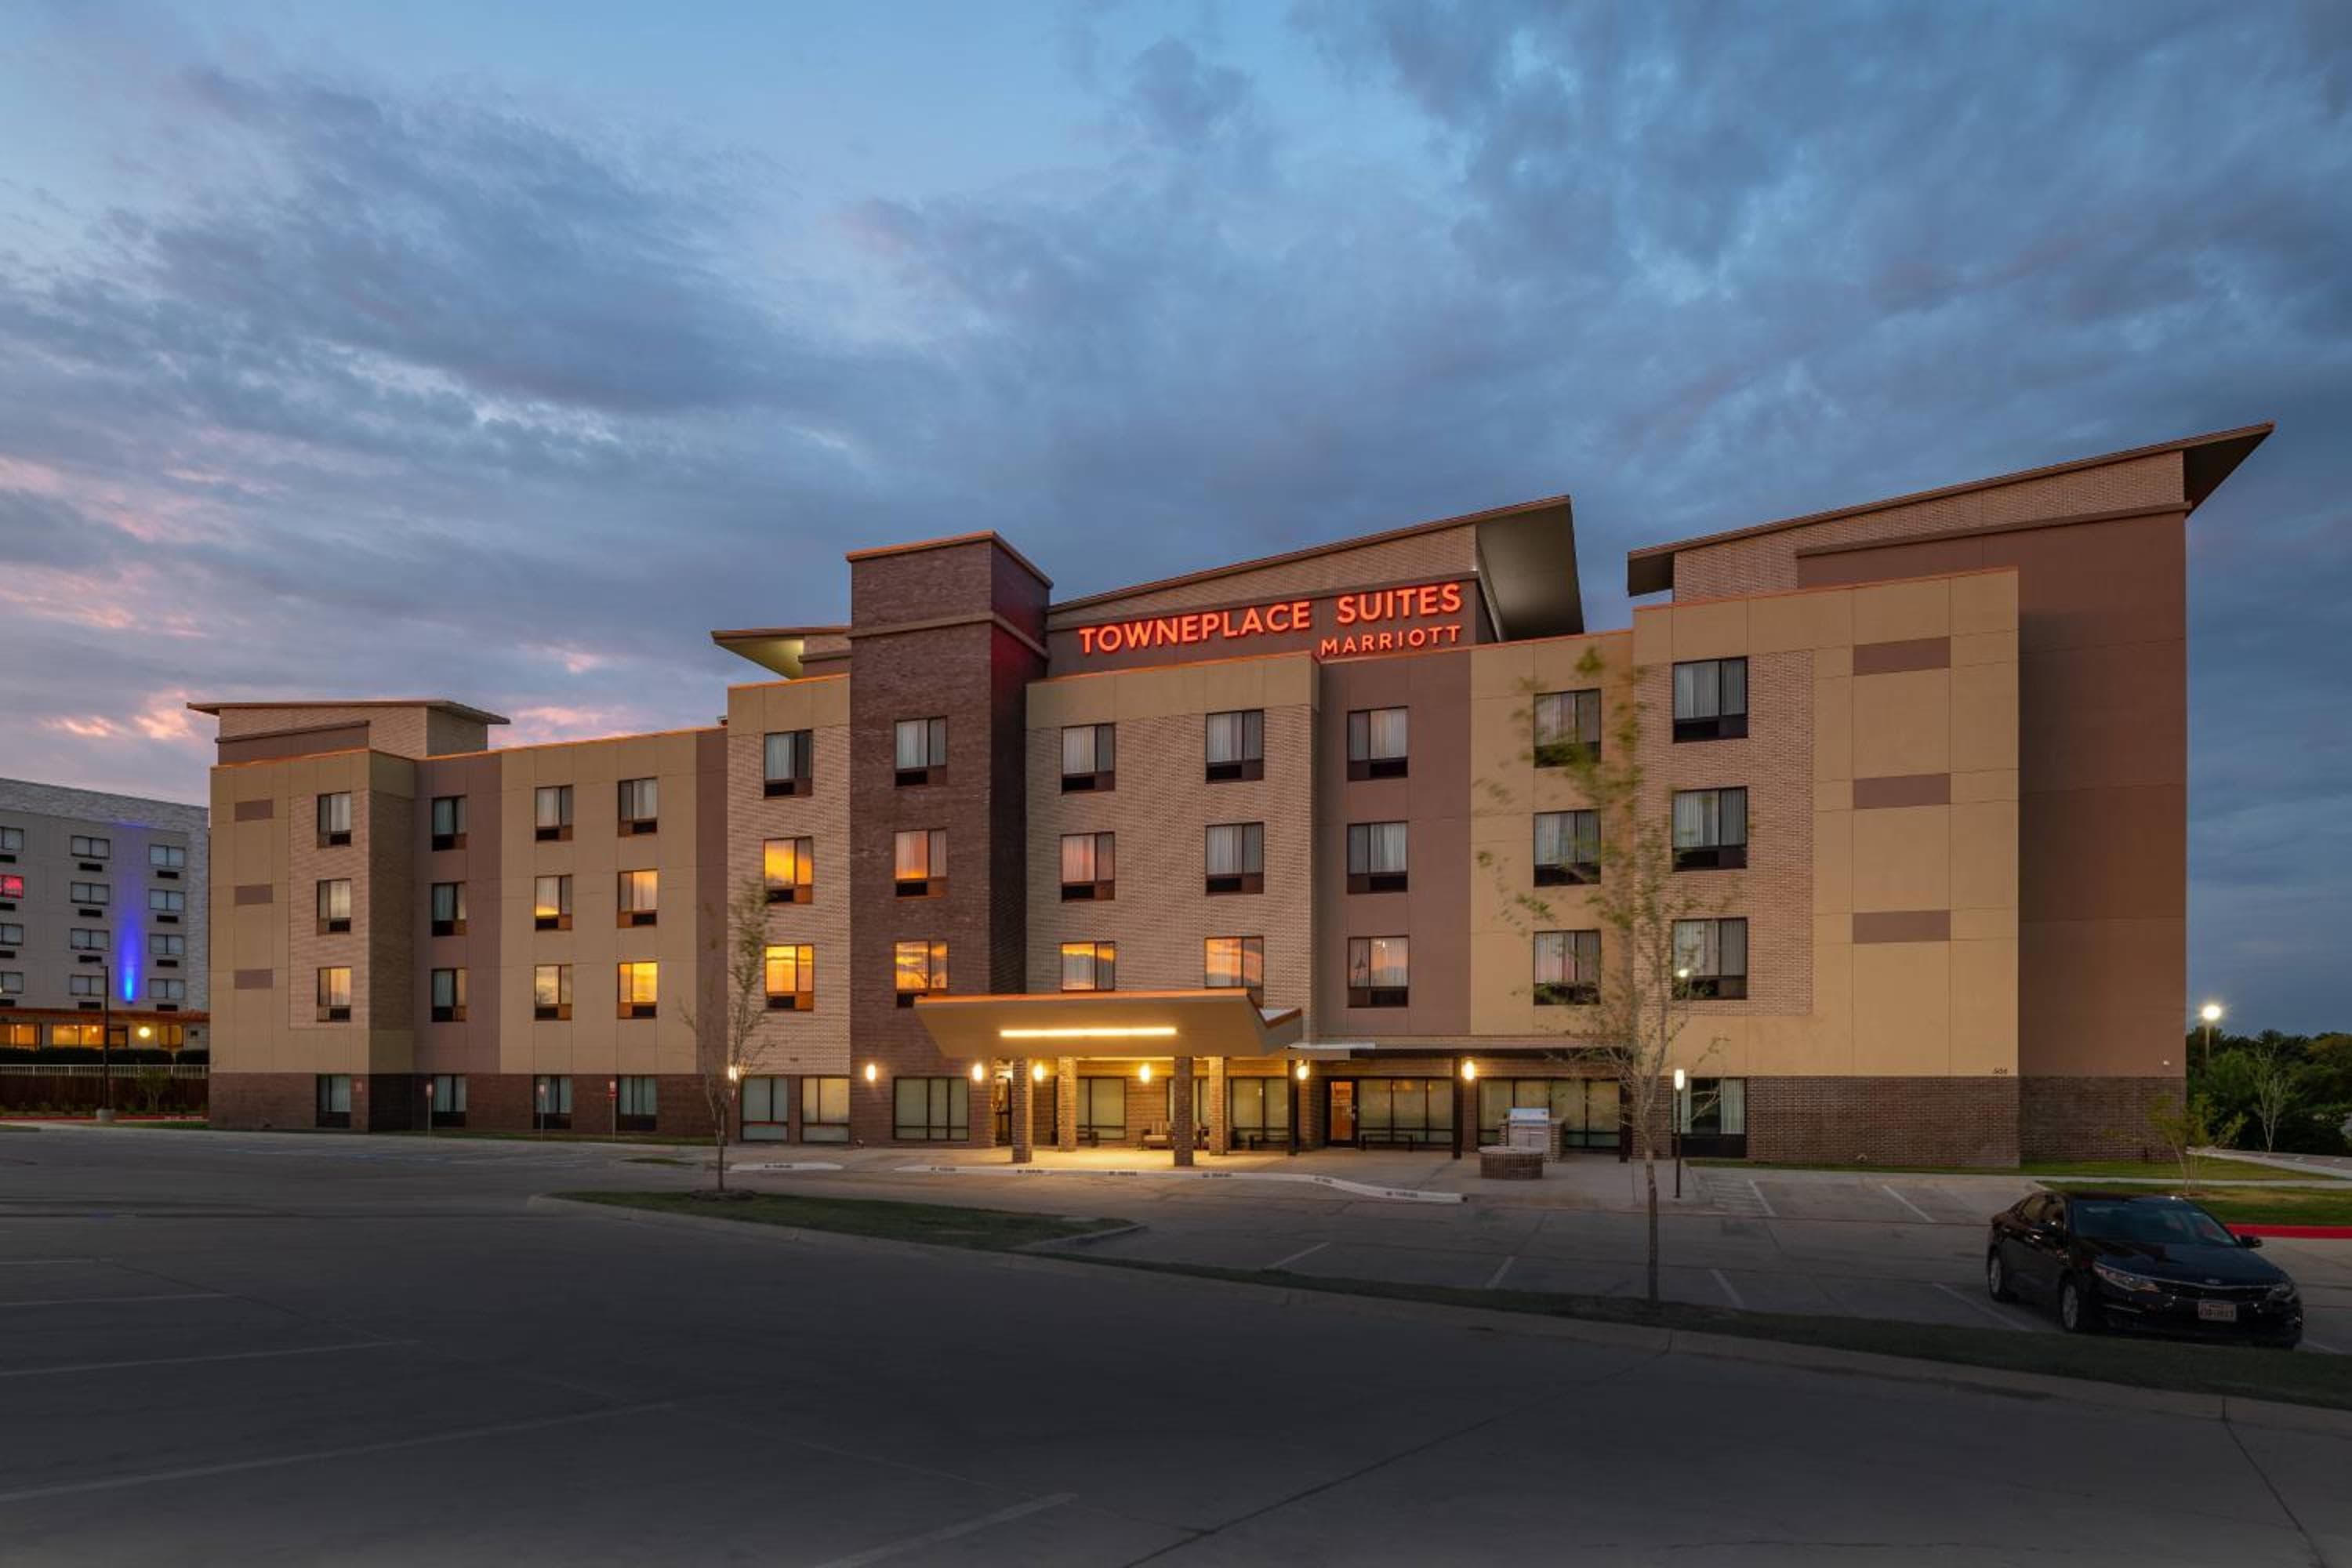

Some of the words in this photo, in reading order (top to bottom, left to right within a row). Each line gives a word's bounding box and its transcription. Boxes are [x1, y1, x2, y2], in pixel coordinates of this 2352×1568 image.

[1079, 601, 1311, 653] TOWNEPLACE
[1337, 583, 1461, 623] SUITES
[1321, 625, 1461, 656] MARRIOTT
